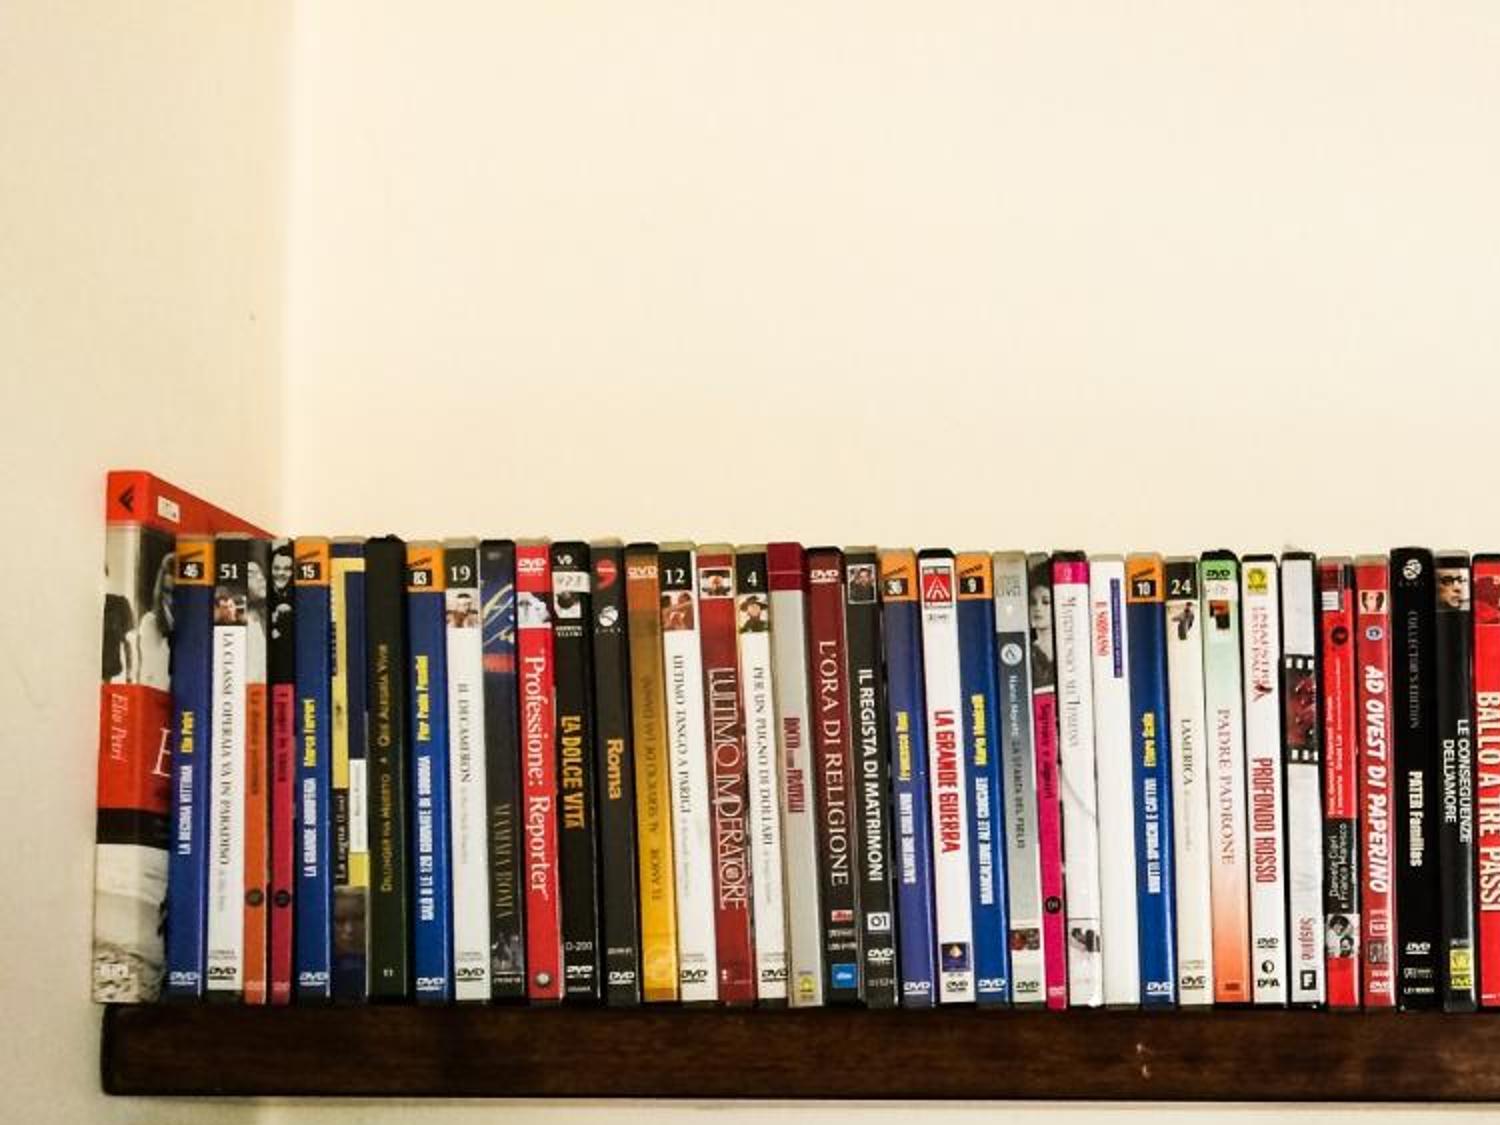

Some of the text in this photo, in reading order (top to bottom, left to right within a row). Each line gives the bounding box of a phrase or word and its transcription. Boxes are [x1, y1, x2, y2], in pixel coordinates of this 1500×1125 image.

[220, 563, 239, 579] 51
[301, 564, 317, 579] 15
[449, 564, 471, 581] 19
[664, 568, 685, 584] 12
[747, 571, 759, 585] 4
[1170, 578, 1192, 595] 24
[222, 632, 234, 647] LA
[221, 651, 234, 696] CLASSE
[458, 684, 471, 692] IL
[672, 655, 686, 705] ULTIMO
[753, 667, 766, 692] PER
[110, 694, 128, 760] Elio Petri
[754, 696, 767, 714] UN
[221, 701, 233, 757] OPERAIA
[458, 699, 472, 782] DECAMERON
[674, 709, 689, 755] TANGO
[755, 719, 770, 765] PUGNO
[220, 762, 232, 777] VA
[560, 716, 585, 828] LA DOLCE VITA
[606, 739, 624, 799] Roma
[676, 758, 689, 767] A
[758, 770, 771, 784] DI
[819, 641, 848, 886] L'ORA DI RELIGIONE
[859, 669, 882, 881] IL REGISTA DI MATRIMONI
[935, 711, 960, 853] LA GRANDE GUERRA
[1366, 666, 1387, 893] AD OVEST DI PAPERINO
[1443, 739, 1457, 823] DELL'AMORE
[1457, 720, 1472, 842] LE CONSEGUENZE
[220, 782, 232, 795] IN
[677, 771, 691, 812] PARIGI
[1217, 709, 1236, 864] PADRE PADRONE
[219, 799, 232, 865] PARADISO
[759, 789, 773, 845] DOLLARI
[1252, 758, 1277, 882] PROFONDO ROSSO
[1410, 771, 1424, 866] PATER Familias
